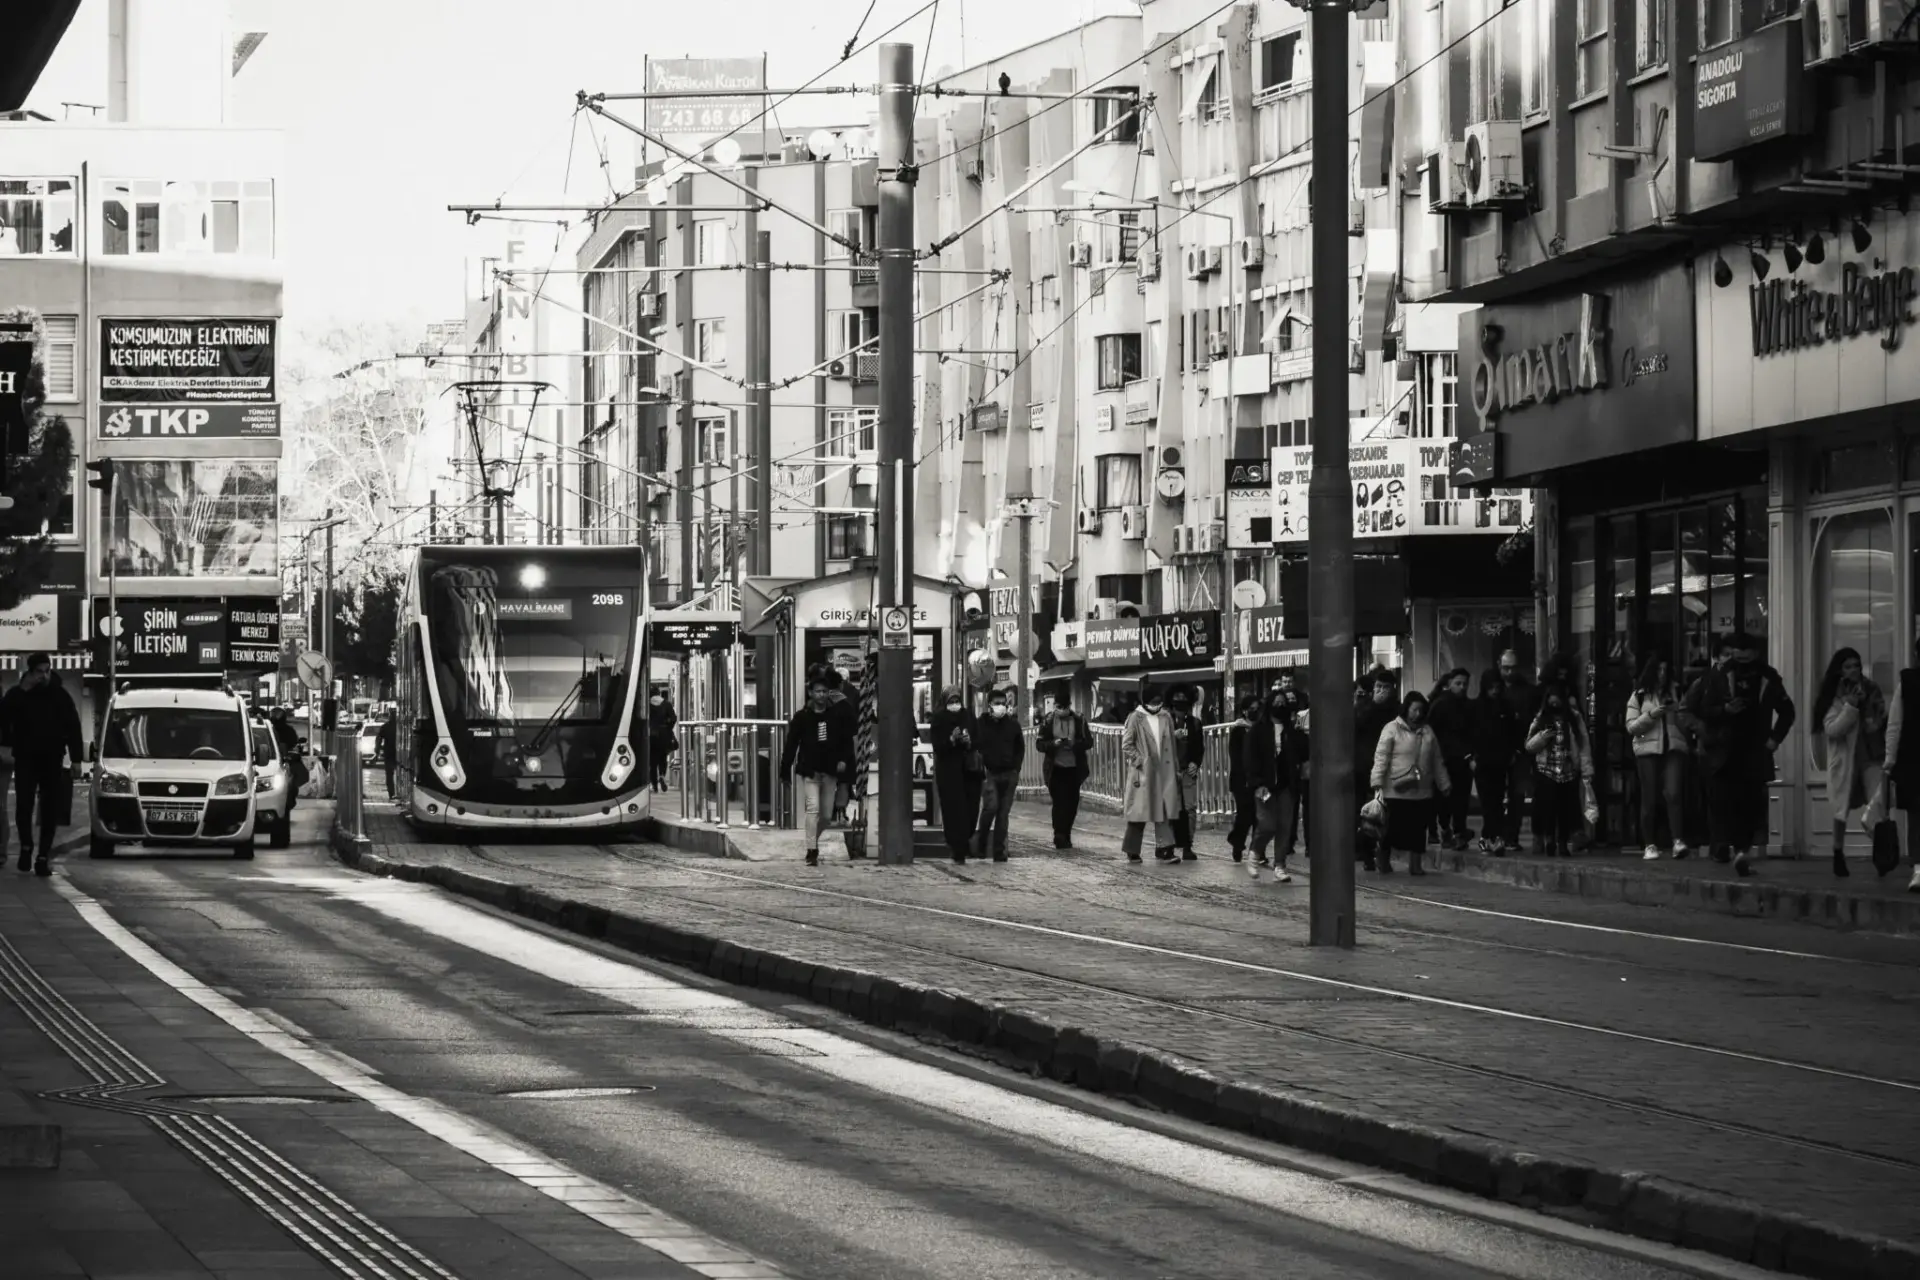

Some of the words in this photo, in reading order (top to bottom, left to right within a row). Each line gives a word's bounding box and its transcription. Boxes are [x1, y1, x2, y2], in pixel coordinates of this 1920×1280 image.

[1698, 51, 1743, 82] ANADOLU
[1698, 81, 1737, 109] SİGORTA
[661, 109, 695, 126] 243
[701, 108, 723, 126] 68
[728, 108, 752, 125] 68
[110, 327, 192, 346] KOMŞUMUZUN
[198, 325, 270, 345] ELEKTRİĞİNİ
[110, 347, 220, 367] KESTİRMEYECEĞİZ!
[135, 409, 210, 435] TKP
[1278, 471, 1294, 485] CEP
[500, 602, 565, 613] HAVALİMANI
[592, 594, 624, 606] 209B
[144, 607, 177, 632] ŞİRİN
[231, 611, 256, 623] FATURA
[256, 609, 278, 624] ÖDEME
[241, 626, 269, 639] MERKEZİ
[1086, 627, 1112, 644] PEYNİR
[134, 632, 187, 657] İLETİŞİM
[231, 648, 255, 662] TEKNİK
[256, 649, 279, 662] SERVİS
